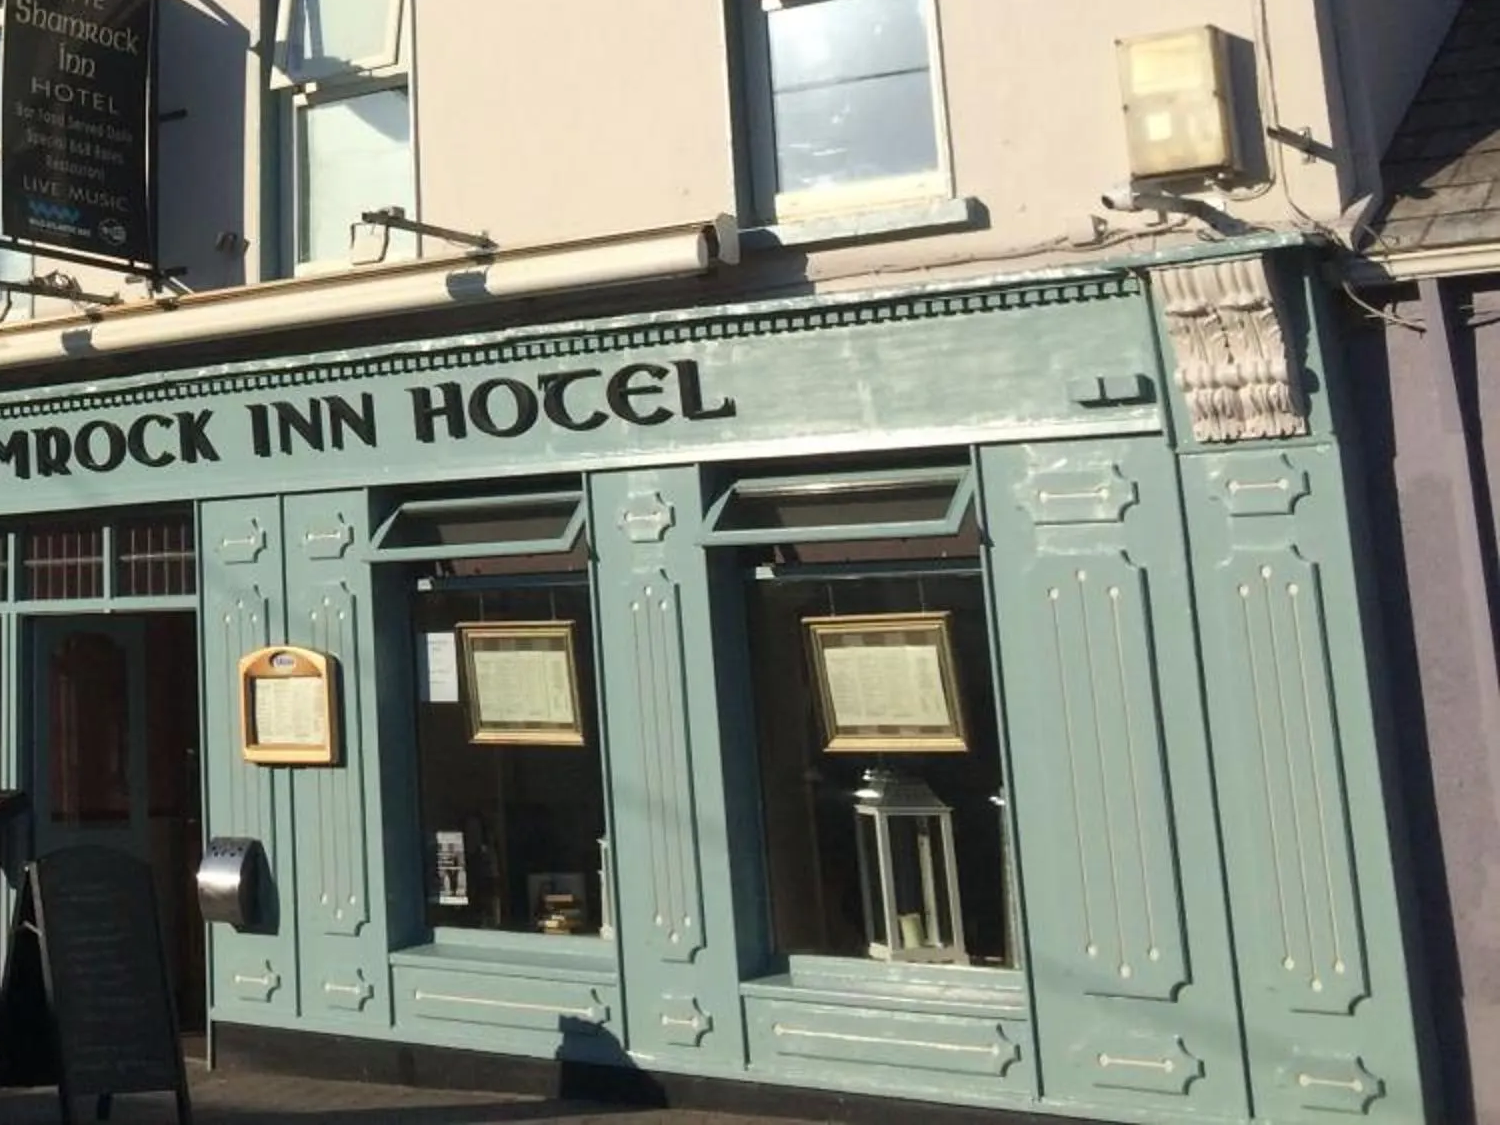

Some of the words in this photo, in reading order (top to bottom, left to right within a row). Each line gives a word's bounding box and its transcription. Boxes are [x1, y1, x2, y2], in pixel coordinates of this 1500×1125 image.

[30, 76, 119, 115] HOTEL
[22, 174, 62, 196] LIVE
[67, 182, 132, 213] MUSIC
[245, 391, 377, 459] INN
[406, 358, 737, 444] HOTEL
